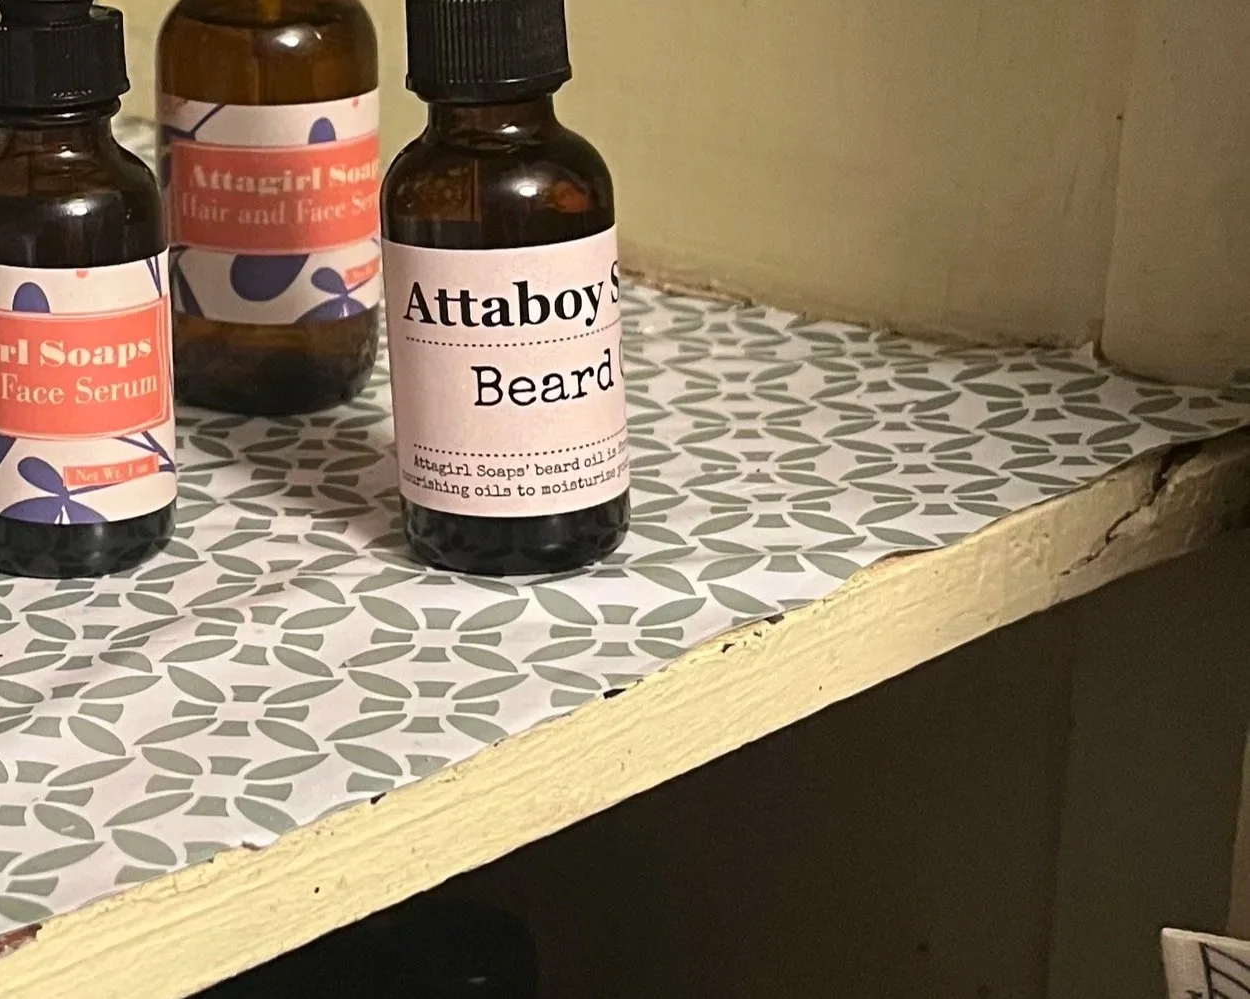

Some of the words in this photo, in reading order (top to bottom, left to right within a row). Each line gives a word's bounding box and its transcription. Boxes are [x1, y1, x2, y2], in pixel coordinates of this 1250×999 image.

[190, 164, 321, 197] Attagirl
[182, 192, 230, 222] Hair
[238, 200, 286, 225] and
[296, 197, 346, 225] Face
[403, 279, 604, 328] Attaboy
[39, 336, 153, 369] Soaps
[0, 372, 65, 405] Face
[75, 374, 158, 405] Serum
[470, 348, 614, 407] Beard
[414, 453, 473, 477] Attagirl
[476, 464, 530, 481] Soaps'
[534, 457, 581, 476] beard
[584, 451, 604, 468] oil
[607, 447, 617, 461] is
[474, 484, 512, 497] oils
[517, 481, 536, 497] to
